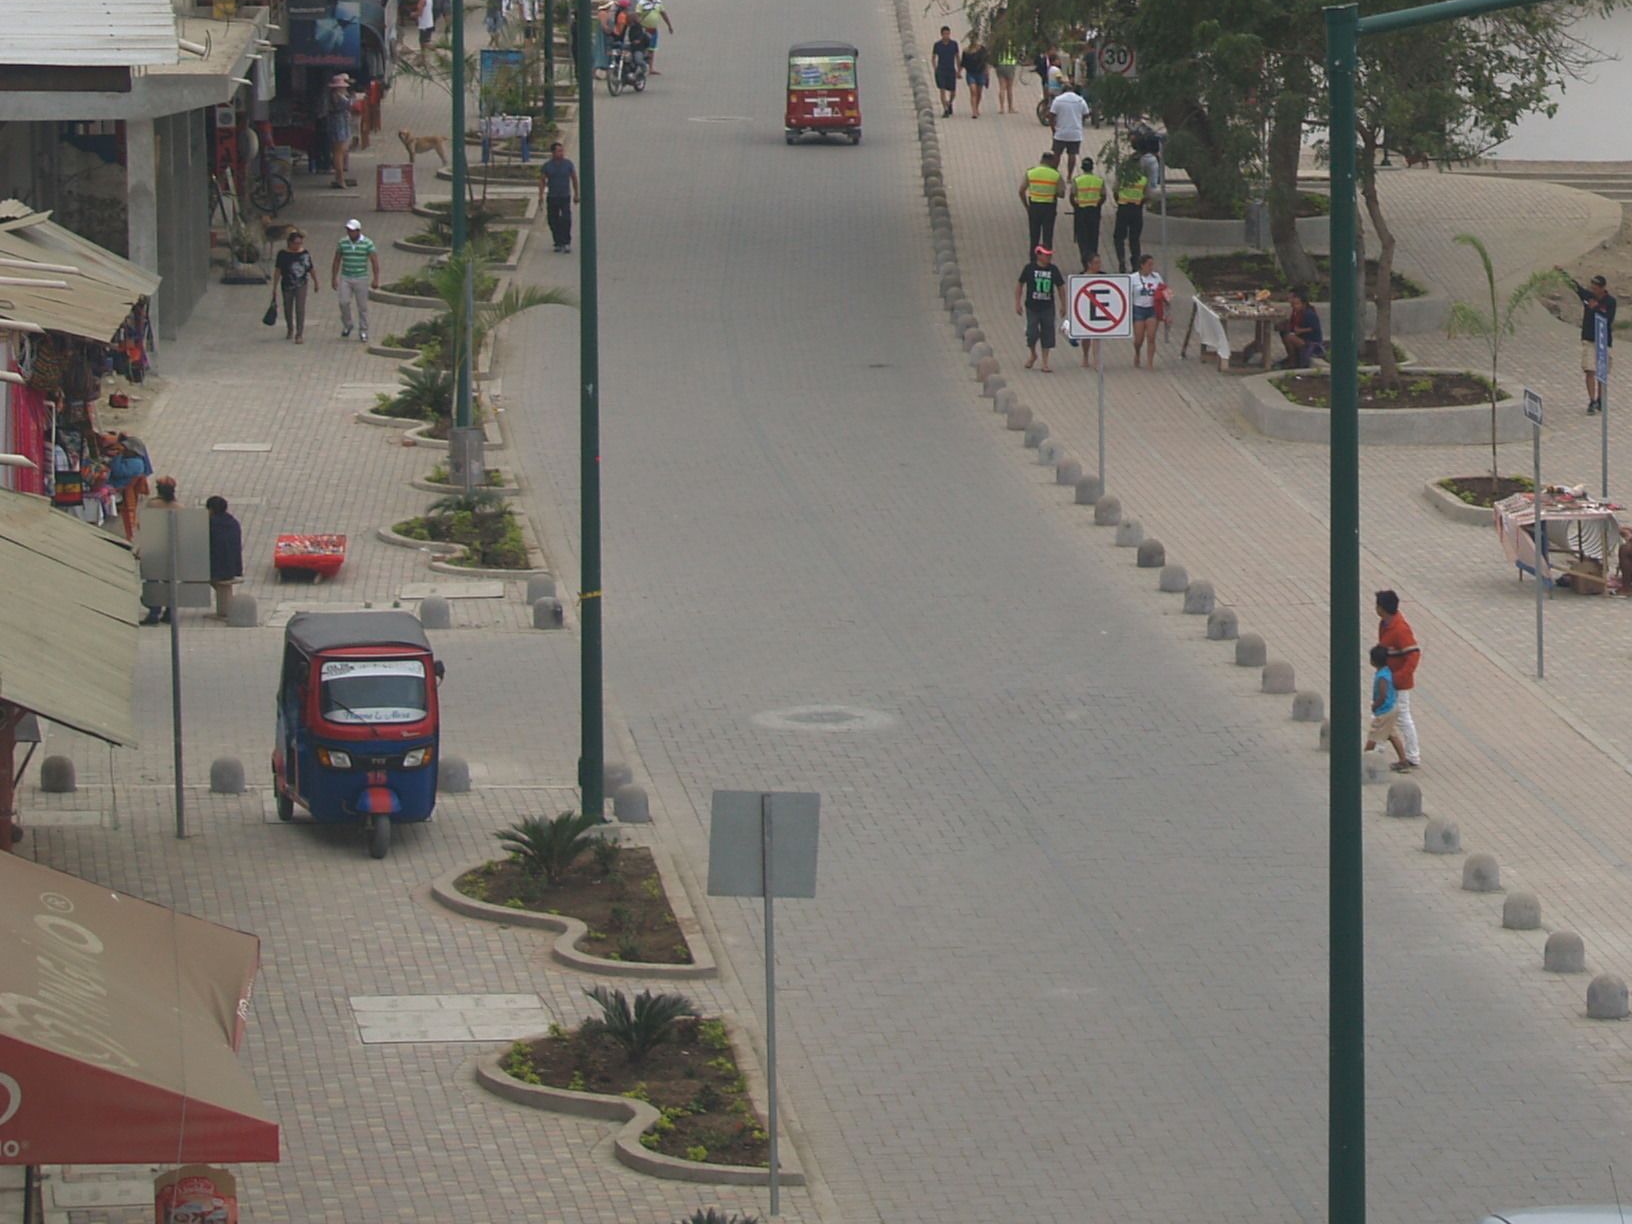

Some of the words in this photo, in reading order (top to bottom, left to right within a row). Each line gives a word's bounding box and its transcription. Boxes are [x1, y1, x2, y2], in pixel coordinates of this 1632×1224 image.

[1104, 48, 1128, 65] 30
[1035, 279, 1051, 292] TO
[1090, 289, 1110, 321] E
